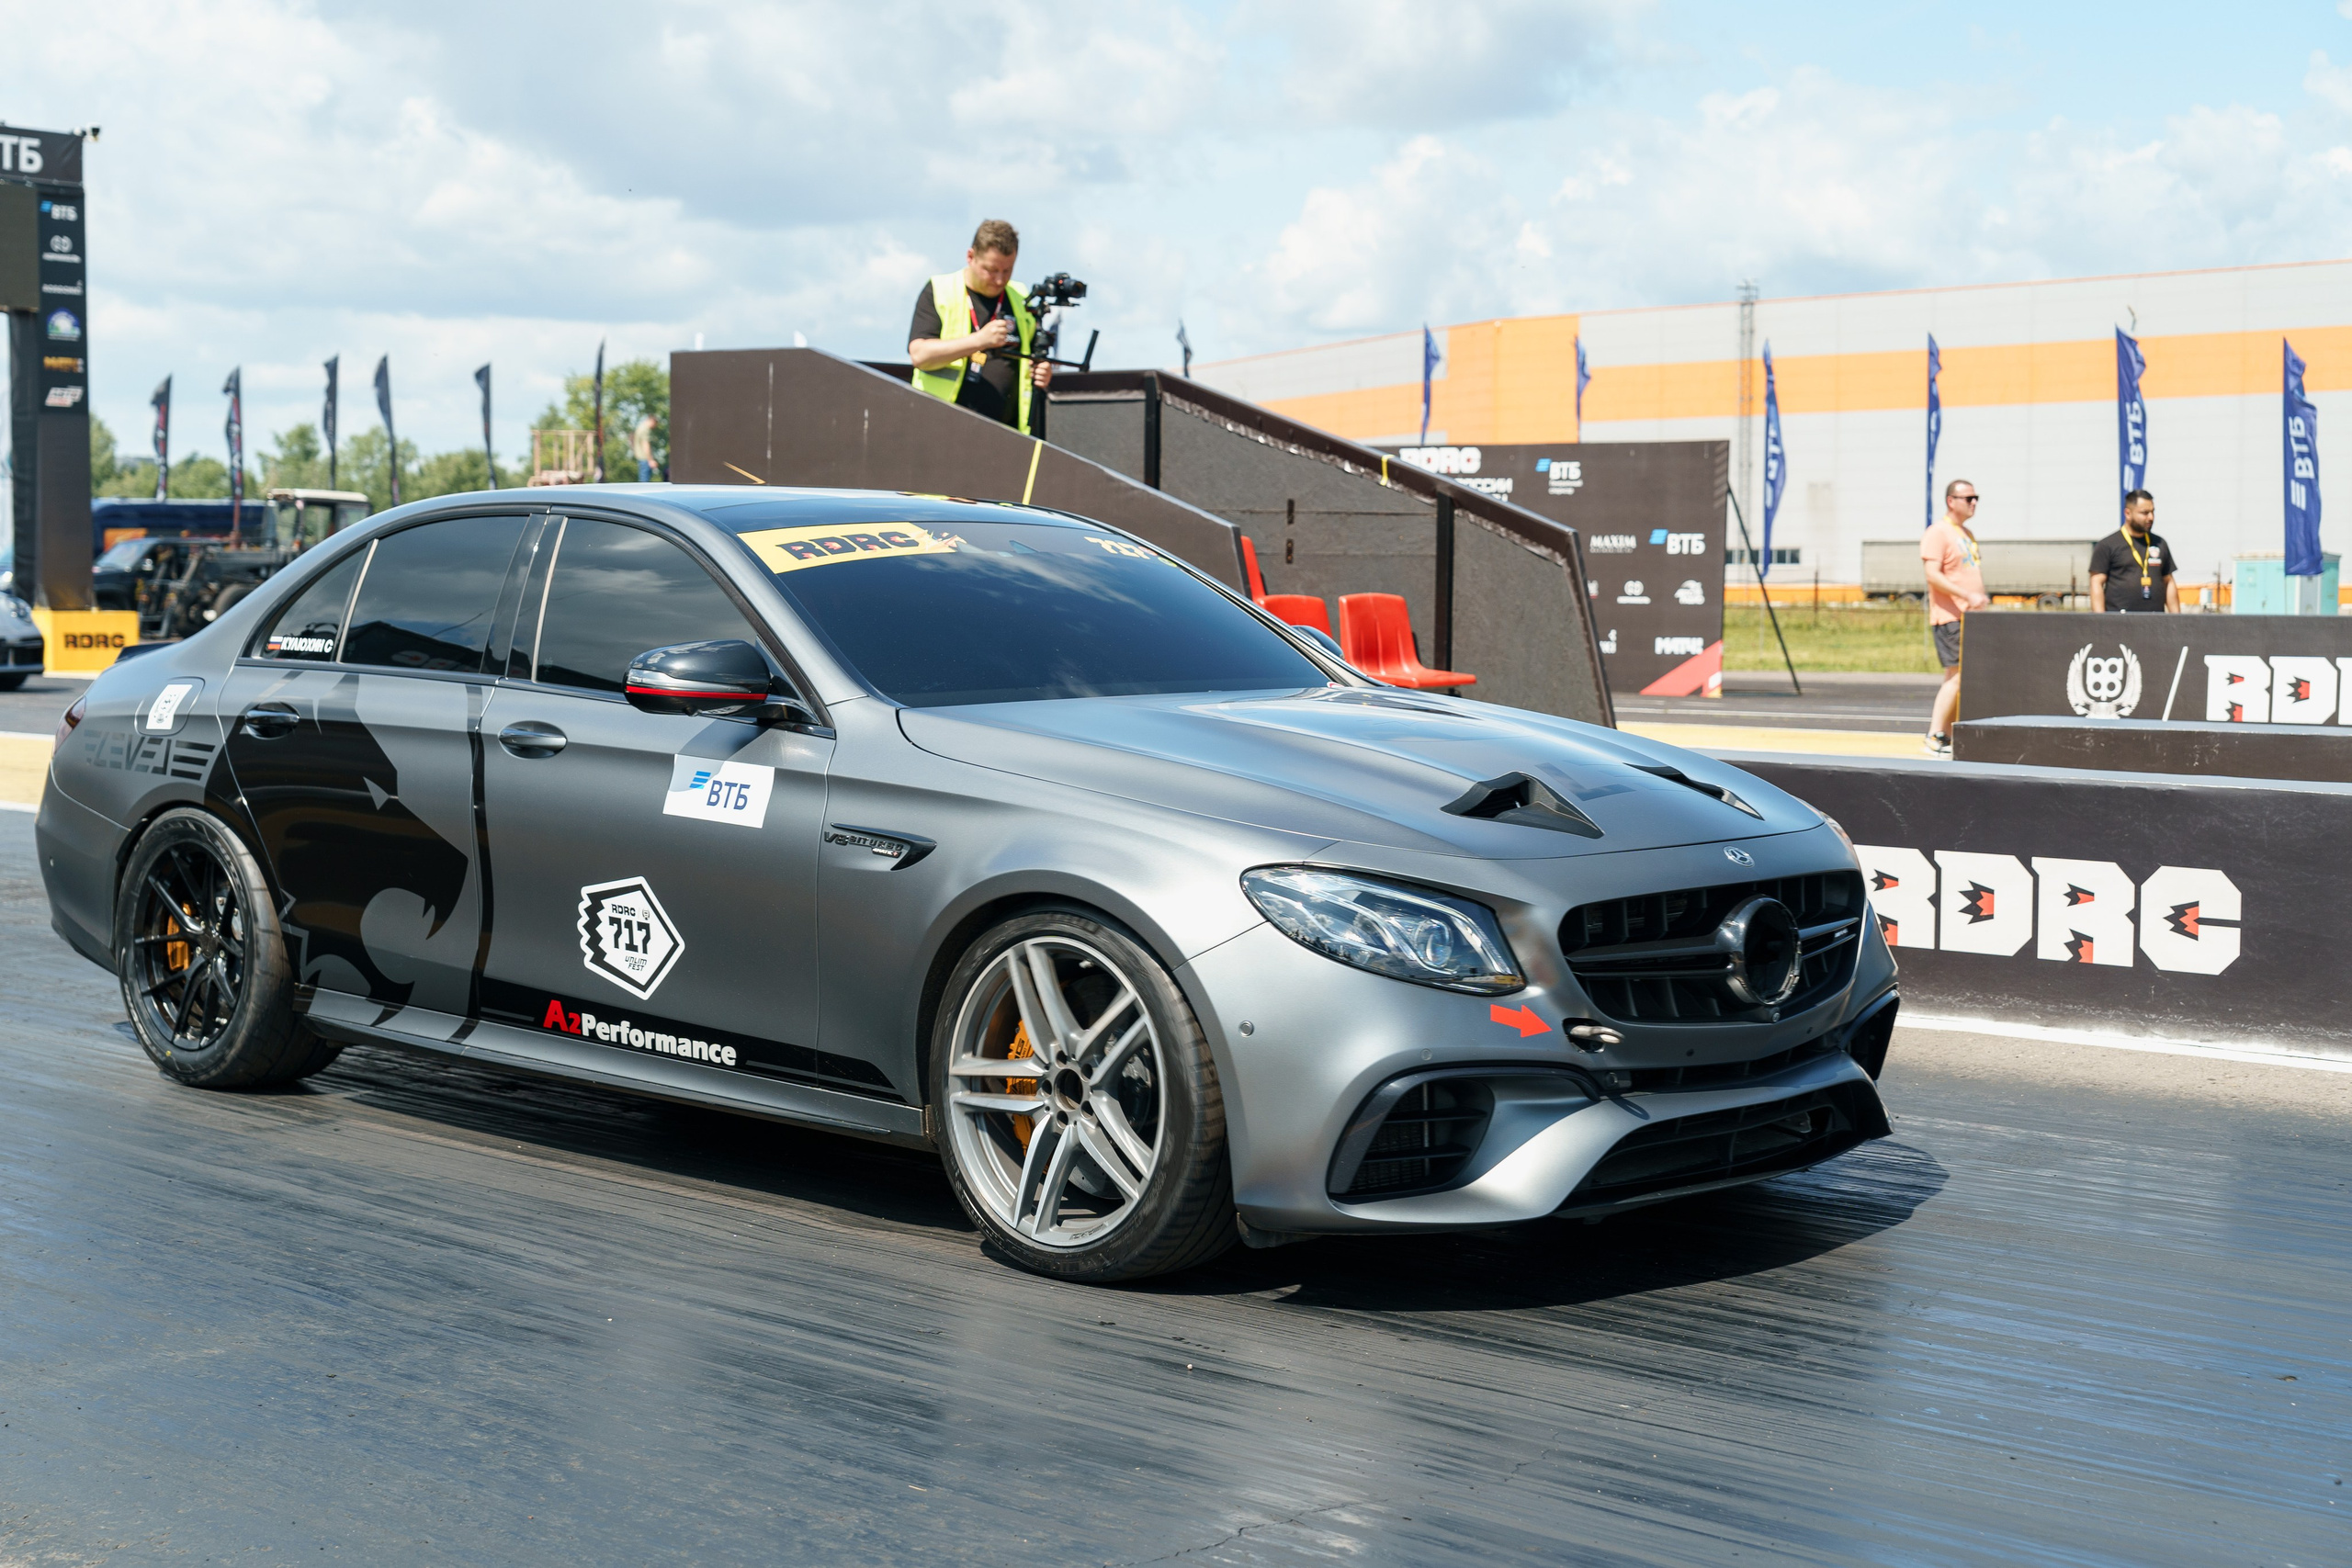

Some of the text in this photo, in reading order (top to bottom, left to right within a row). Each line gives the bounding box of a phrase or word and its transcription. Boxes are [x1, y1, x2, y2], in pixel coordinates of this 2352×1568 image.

[51, 204, 78, 221] ВТБ
[2126, 401, 2144, 466] ВТБ
[2289, 416, 2314, 479] ВТБ
[1549, 461, 1581, 480] ВТБ
[1454, 478, 1513, 493] ССИИ
[776, 531, 919, 560] RDRC
[1589, 535, 1636, 549] MAXIM
[1667, 533, 1706, 555] ВТБ
[63, 634, 126, 649] RDRC
[2203, 654, 2352, 726] RD
[707, 780, 751, 810] ВТБ
[824, 831, 848, 846] V8
[611, 904, 636, 917] RDRC
[1853, 844, 2242, 976] RDRC
[608, 916, 650, 954] 717
[628, 963, 644, 971] FEST
